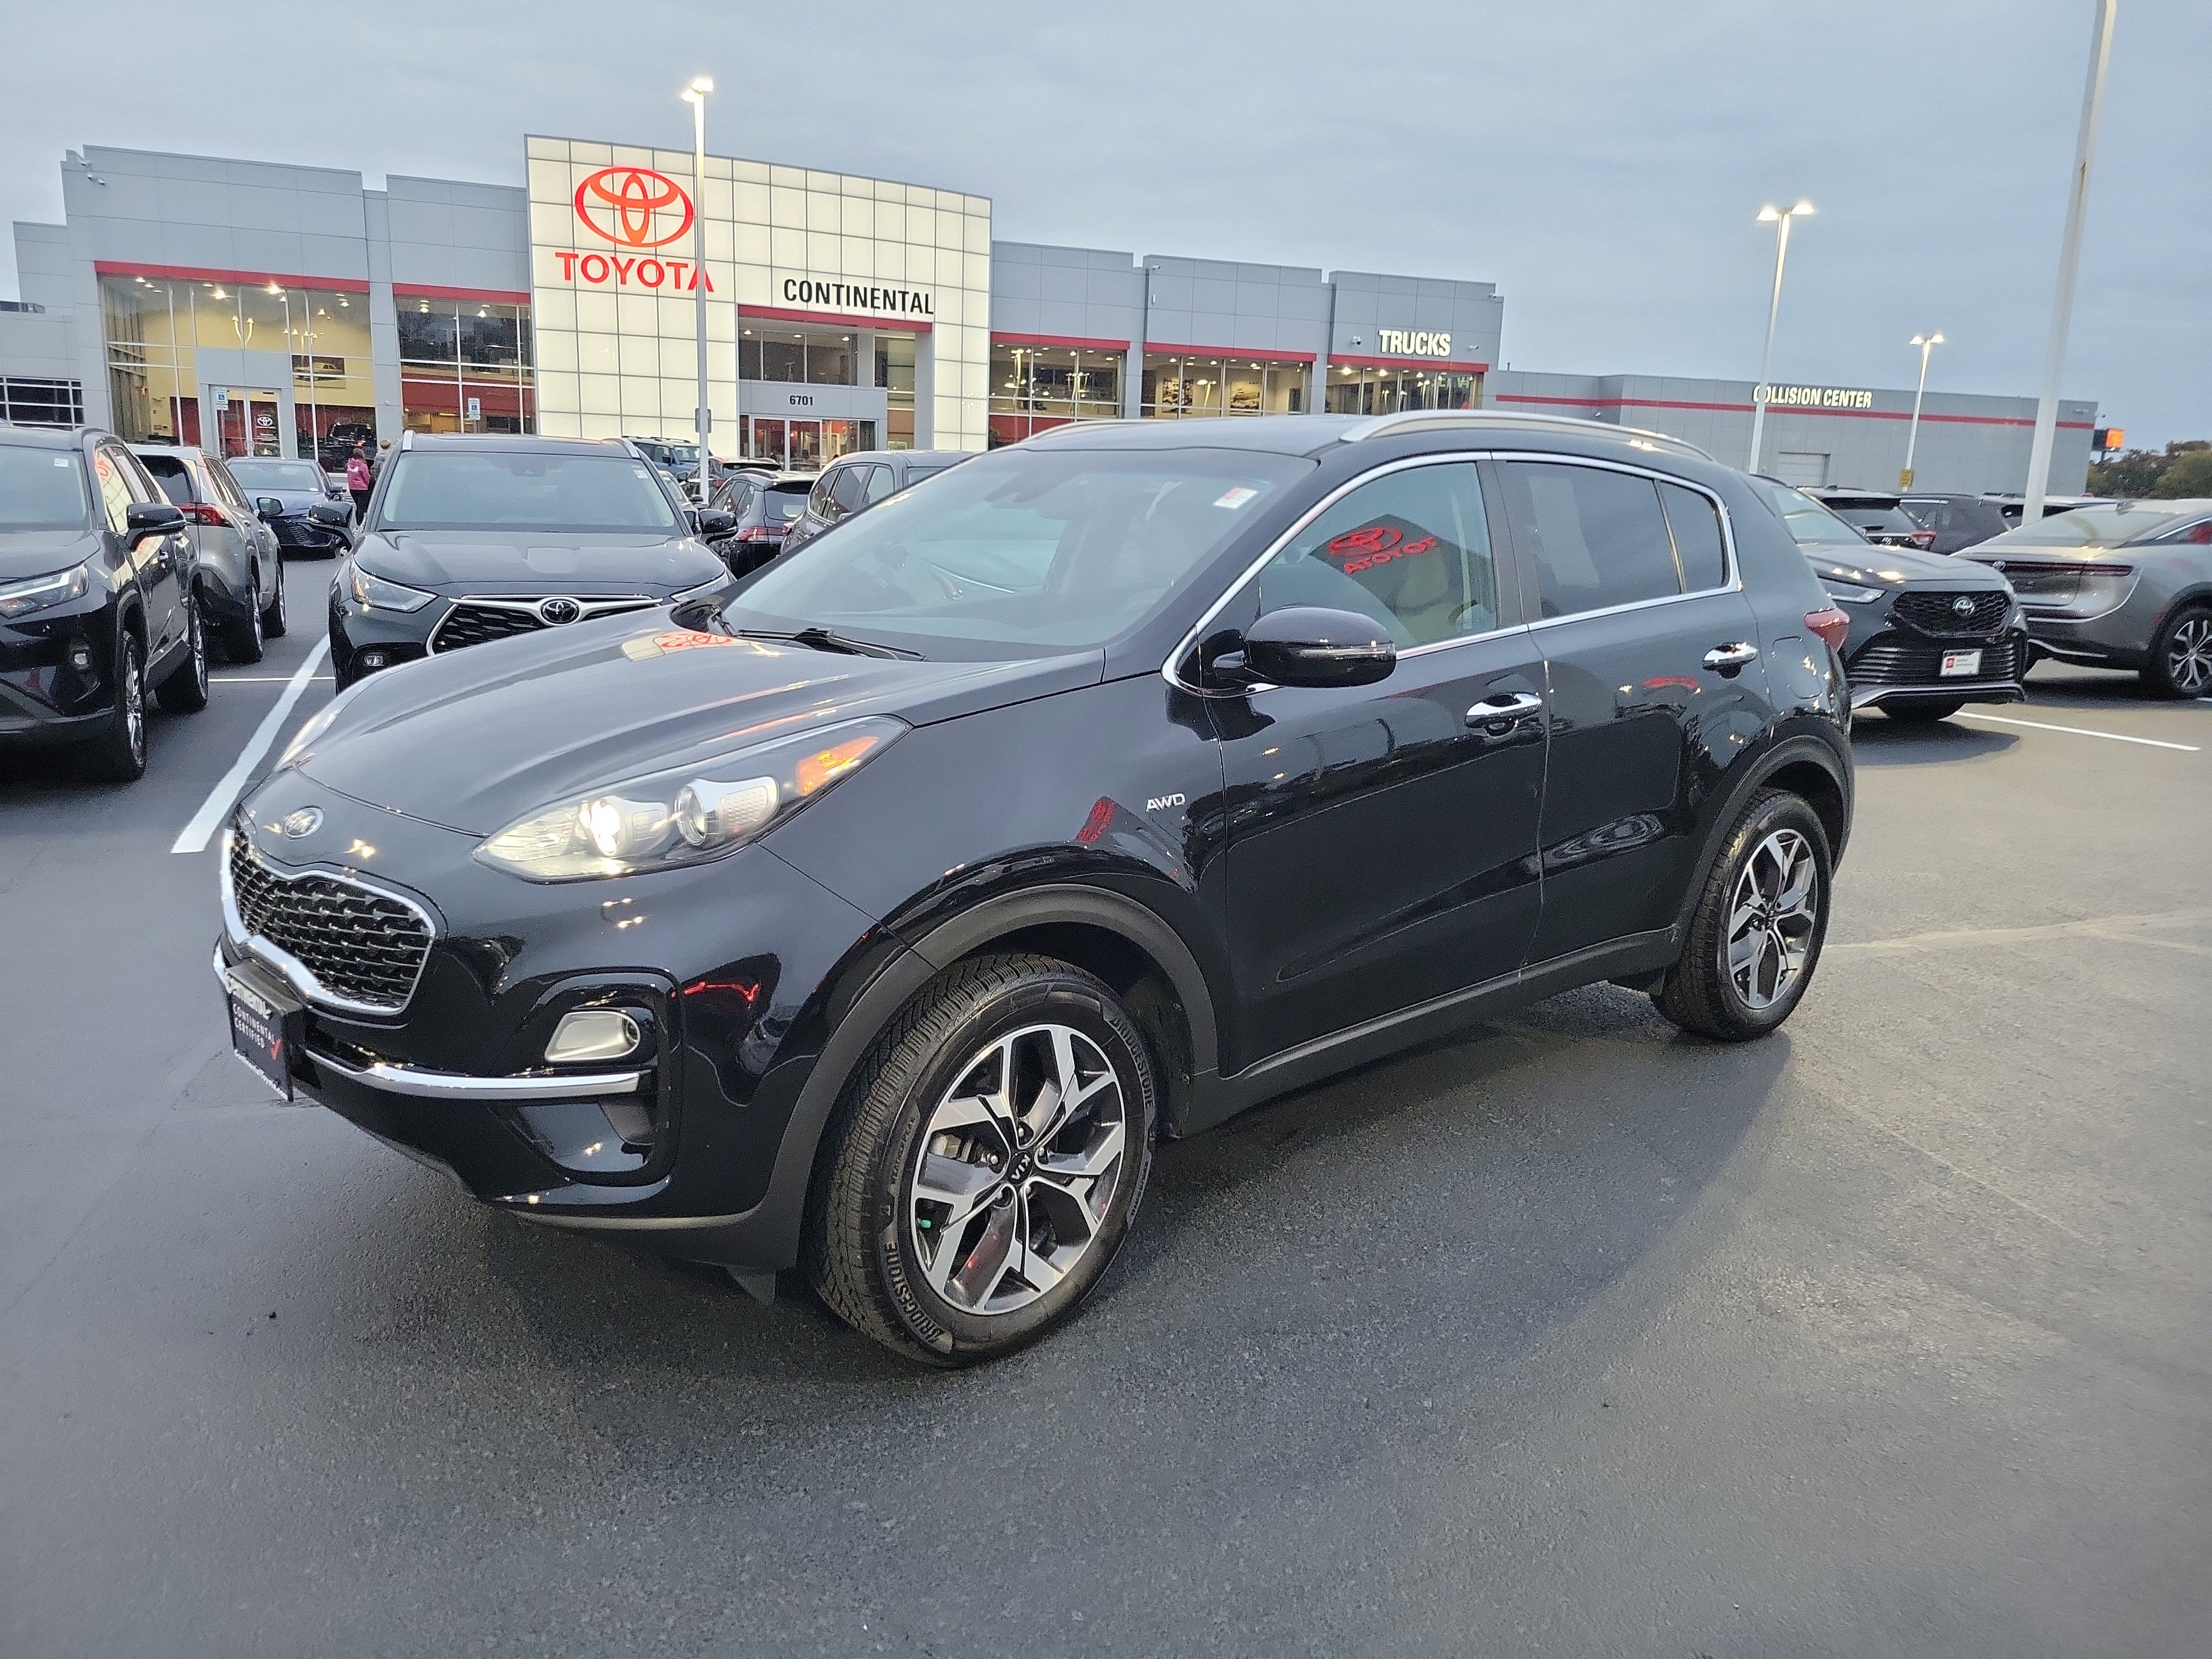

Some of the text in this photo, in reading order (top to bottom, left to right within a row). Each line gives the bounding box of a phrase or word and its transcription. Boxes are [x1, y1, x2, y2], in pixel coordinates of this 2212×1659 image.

[555, 252, 715, 293] TOYOTA
[783, 278, 934, 315] CONTINENTAL
[1378, 330, 1451, 357] TRUCKS
[789, 395, 813, 406] 6701
[1753, 385, 1872, 408] COLLISION CENTER
[1145, 793, 1186, 812] AWD
[1011, 1154, 1031, 1180] KIA
